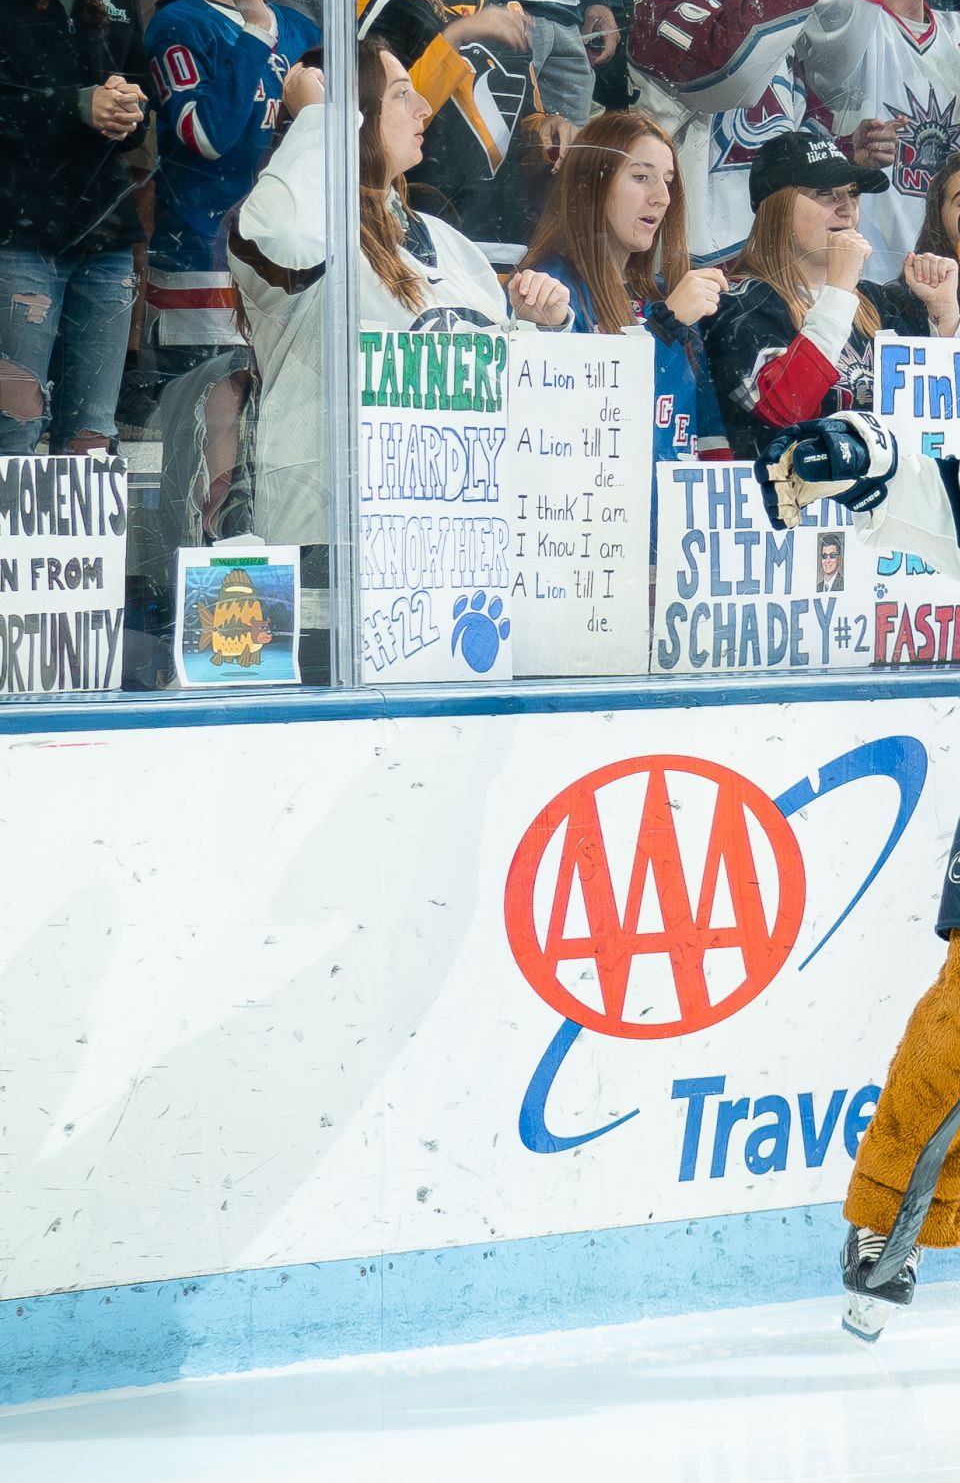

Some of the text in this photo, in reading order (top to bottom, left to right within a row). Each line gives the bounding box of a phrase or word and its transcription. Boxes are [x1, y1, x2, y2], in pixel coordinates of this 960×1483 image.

[150, 44, 201, 105] 10
[806, 151, 829, 164] like
[359, 332, 507, 413] TANNER?
[518, 360, 532, 388] A
[543, 360, 574, 390] Lion
[611, 360, 619, 389] I
[379, 422, 506, 502] HARDLY
[517, 427, 532, 453] A
[539, 428, 572, 457] Lion
[608, 428, 621, 458] I
[517, 494, 527, 520] I
[582, 493, 594, 522] I
[673, 467, 753, 530] THE
[30, 556, 104, 591] FROM
[360, 514, 510, 589] KNOW HER
[516, 532, 526, 558] I
[580, 532, 591, 558] I
[676, 528, 795, 599] SLIM
[510, 571, 527, 598] A
[535, 571, 567, 599] Lion
[363, 589, 441, 672] #22
[657, 596, 870, 669] SCHADEY #2
[541, 768, 772, 1025] AAA
